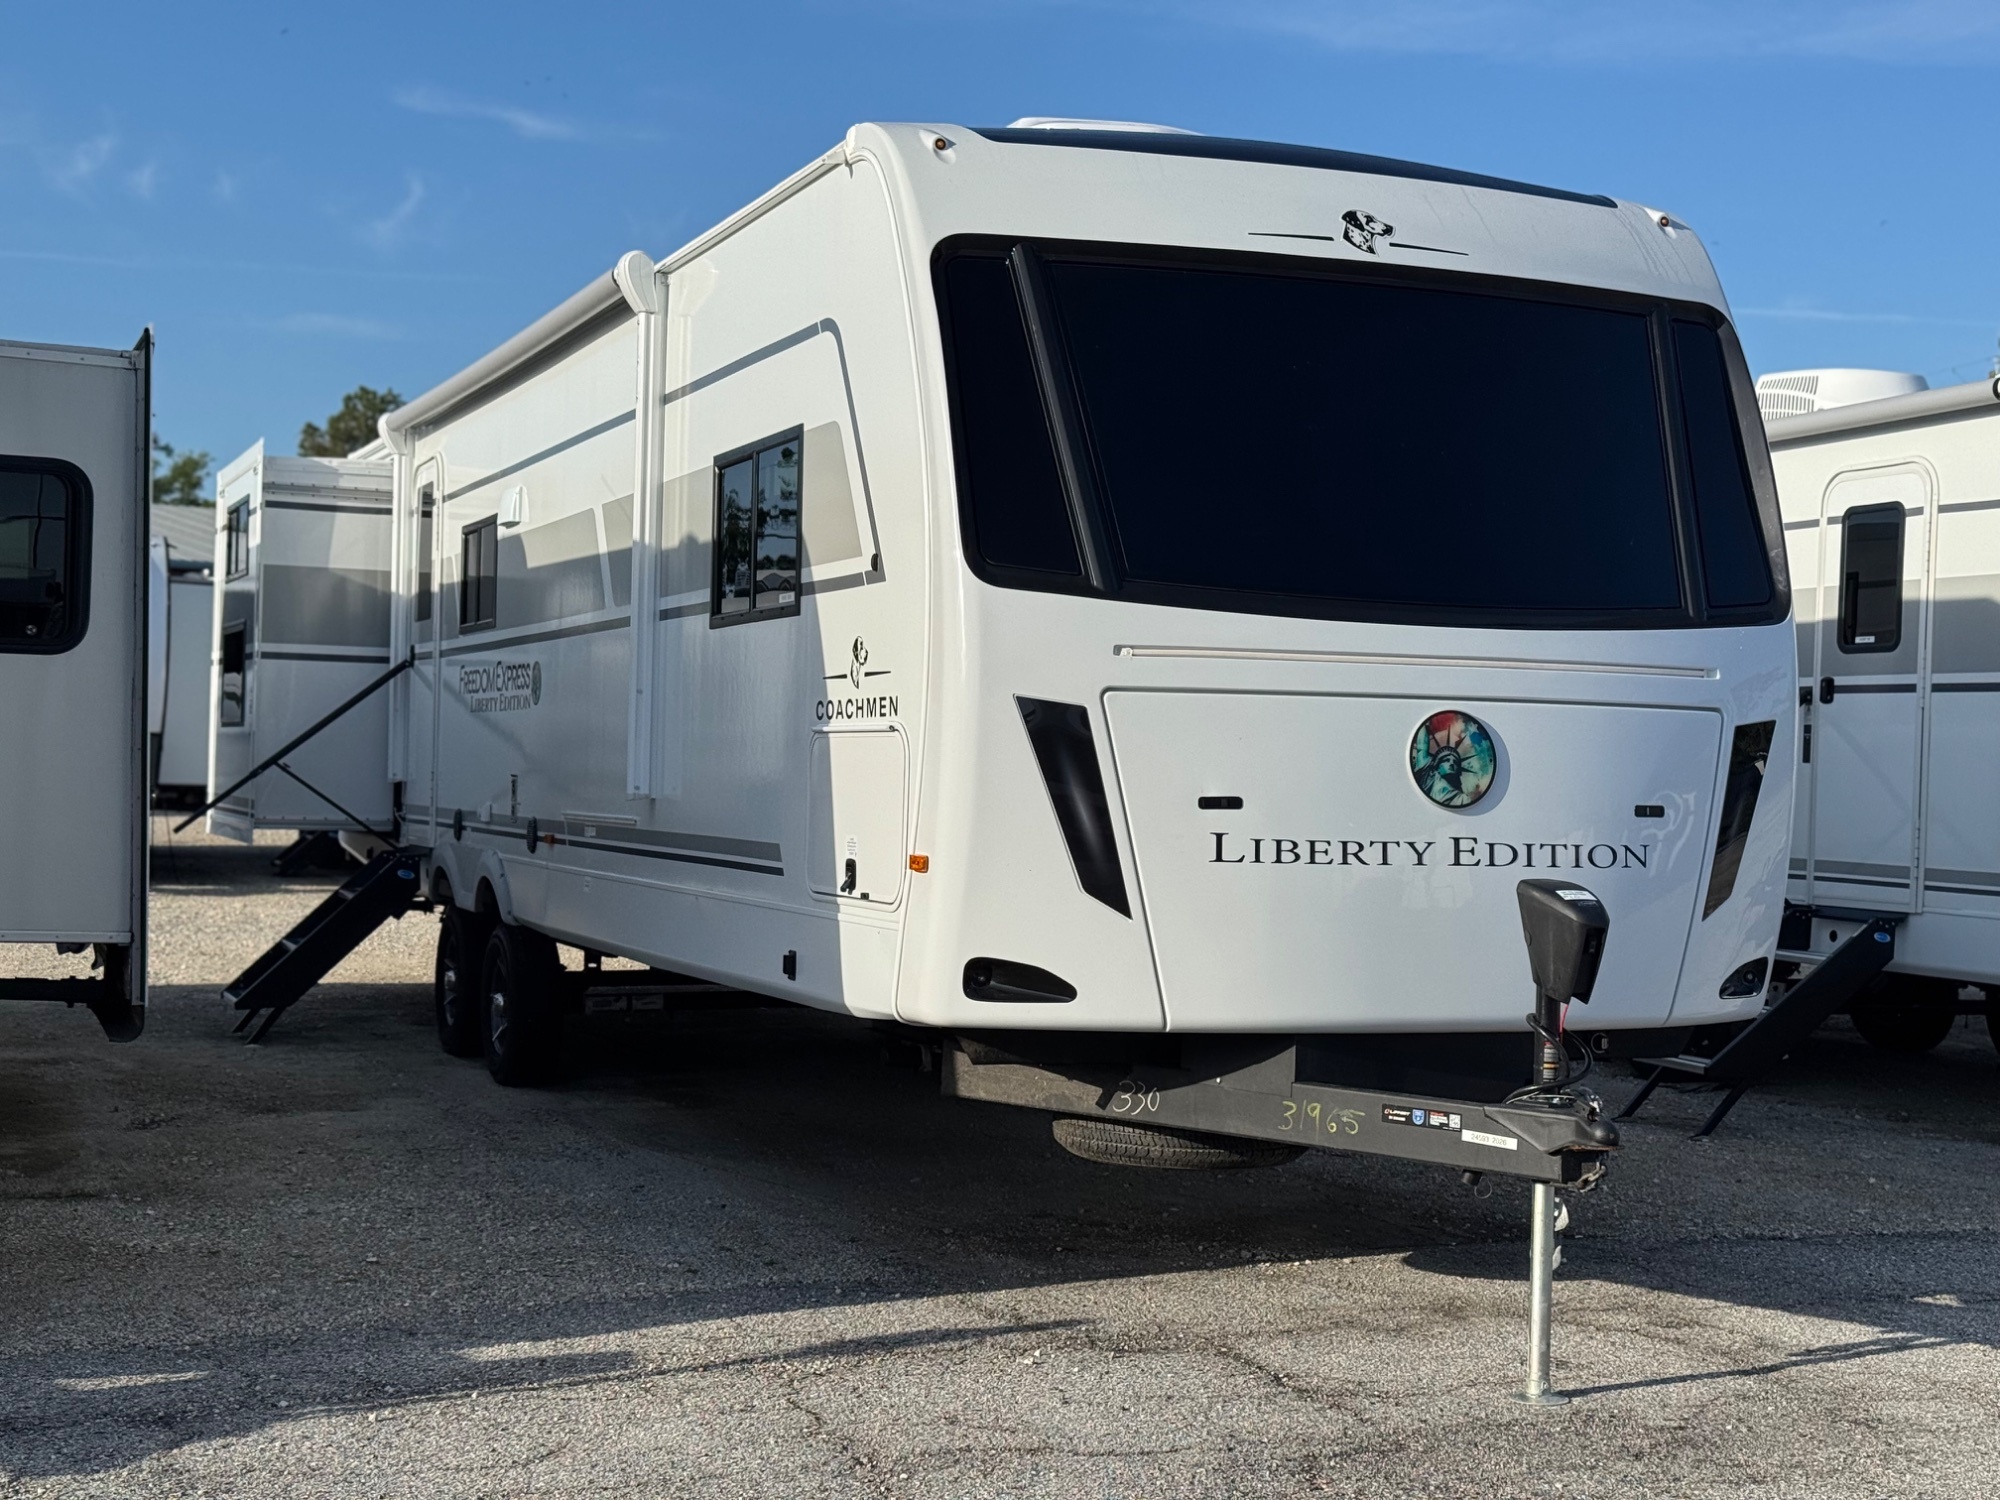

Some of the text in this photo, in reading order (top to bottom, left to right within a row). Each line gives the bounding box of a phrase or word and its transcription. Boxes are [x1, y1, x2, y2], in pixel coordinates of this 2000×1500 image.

[470, 693, 531, 713] LIBERTY EDITION
[815, 695, 899, 721] COACHMEN
[1208, 831, 1651, 869] LIBERTY EDITION
[1112, 1080, 1161, 1115] 330
[1277, 1099, 1366, 1142] 31965
